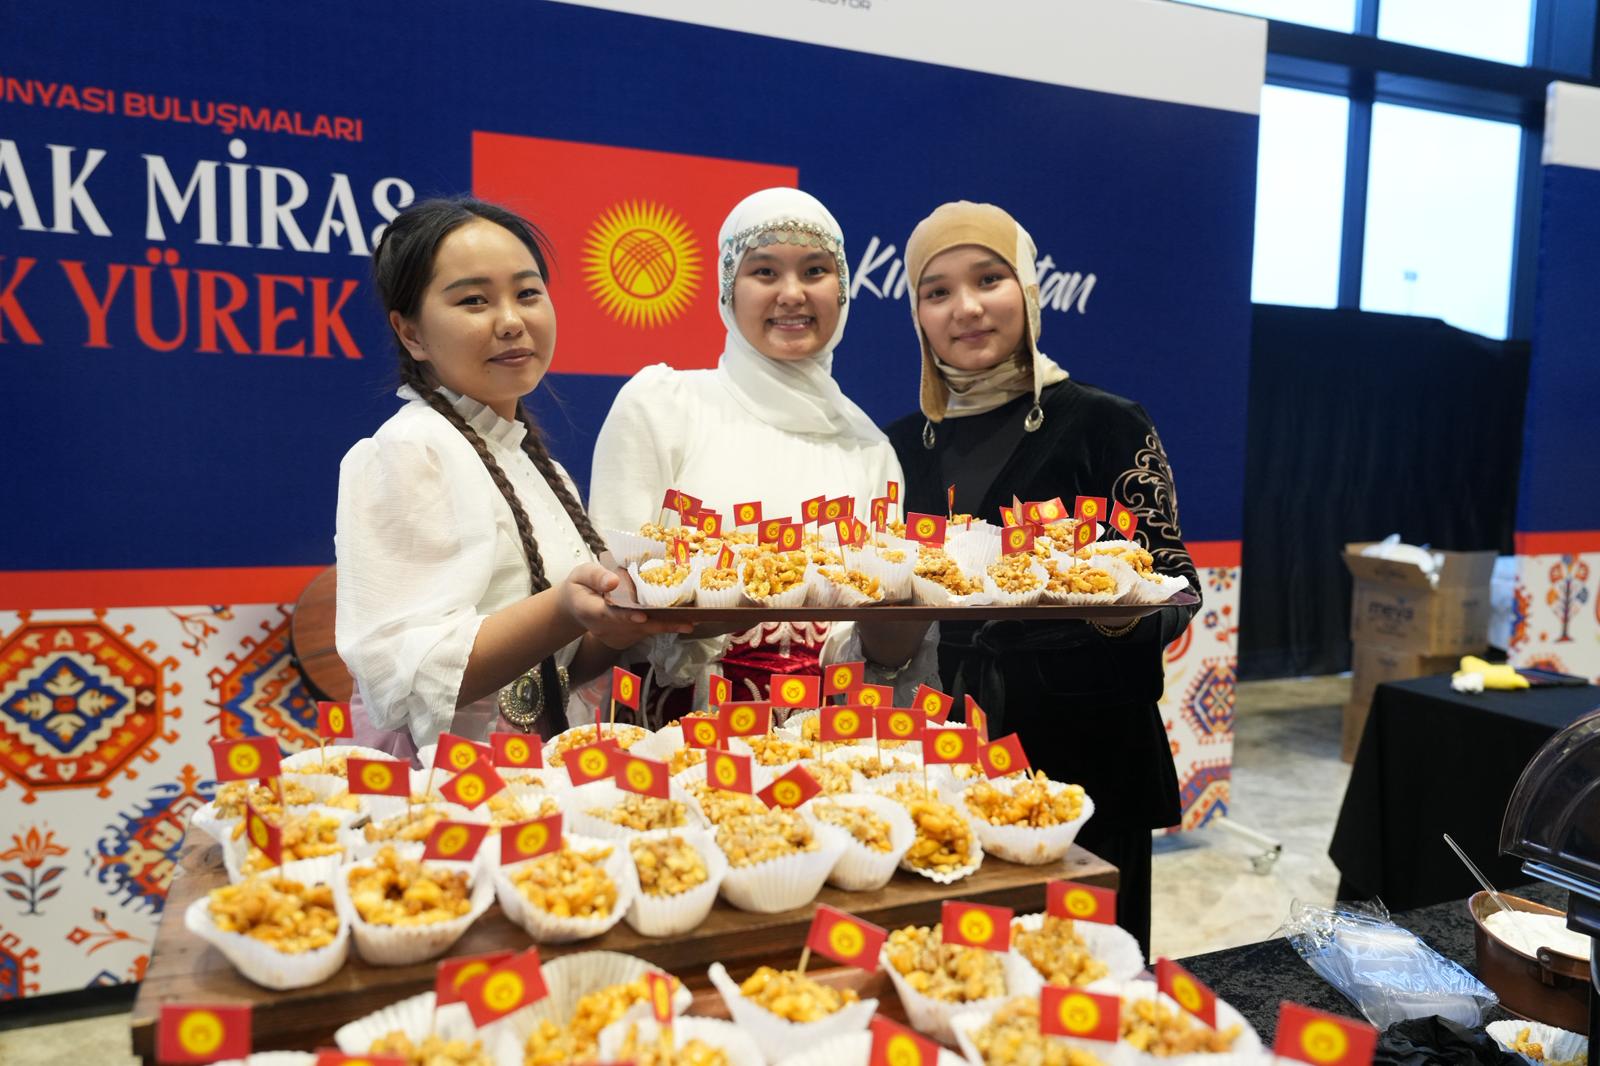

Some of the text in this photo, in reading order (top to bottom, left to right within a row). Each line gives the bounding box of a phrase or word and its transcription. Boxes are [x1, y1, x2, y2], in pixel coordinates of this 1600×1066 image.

[0, 77, 363, 141] NYASI BULUŞMALARI
[143, 138, 415, 257] MİRAS
[60, 247, 363, 359] YÜREK
